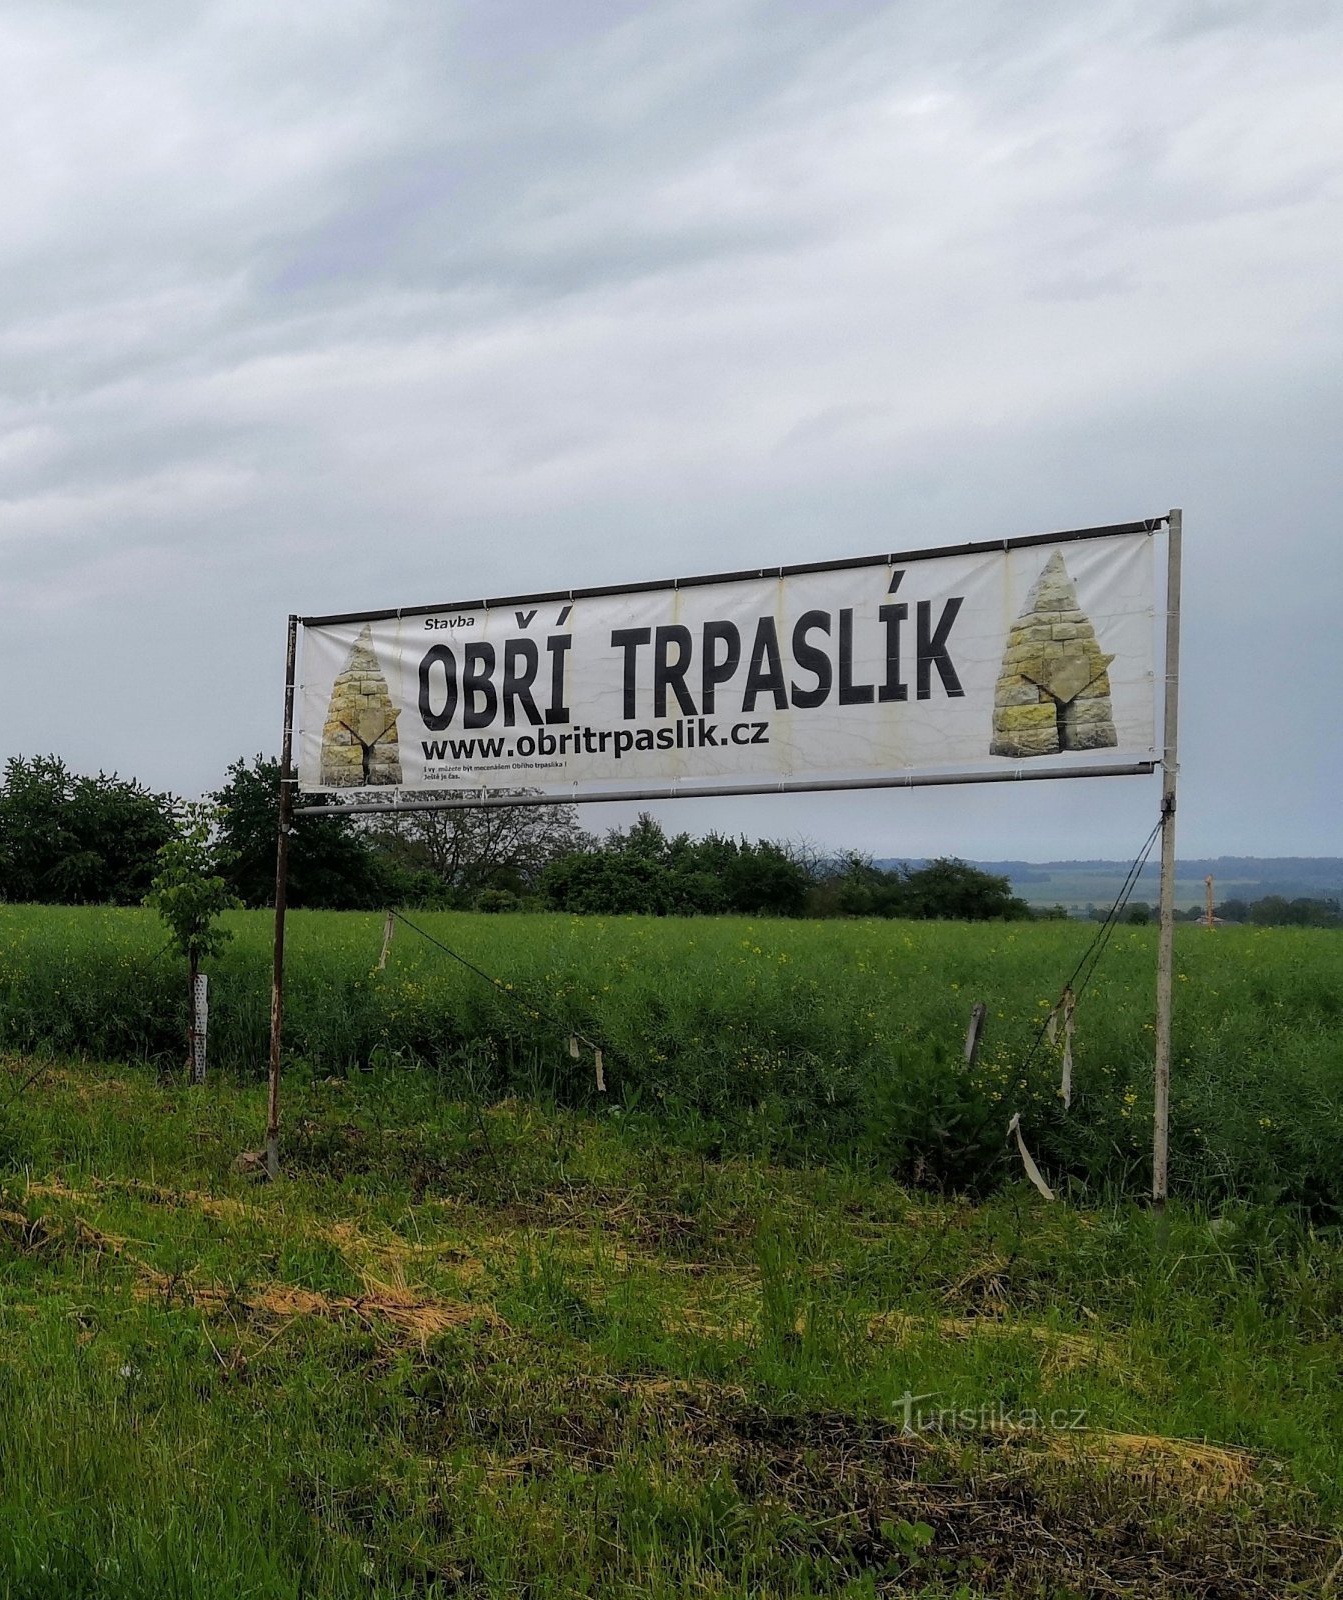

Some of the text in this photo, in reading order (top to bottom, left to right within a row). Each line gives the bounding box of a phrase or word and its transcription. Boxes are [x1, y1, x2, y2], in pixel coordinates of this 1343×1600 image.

[423, 615, 475, 631] Stavba
[418, 570, 965, 732] OBŘÍ TRPASLÍK
[421, 719, 770, 760] www.obritrpaslik.cz
